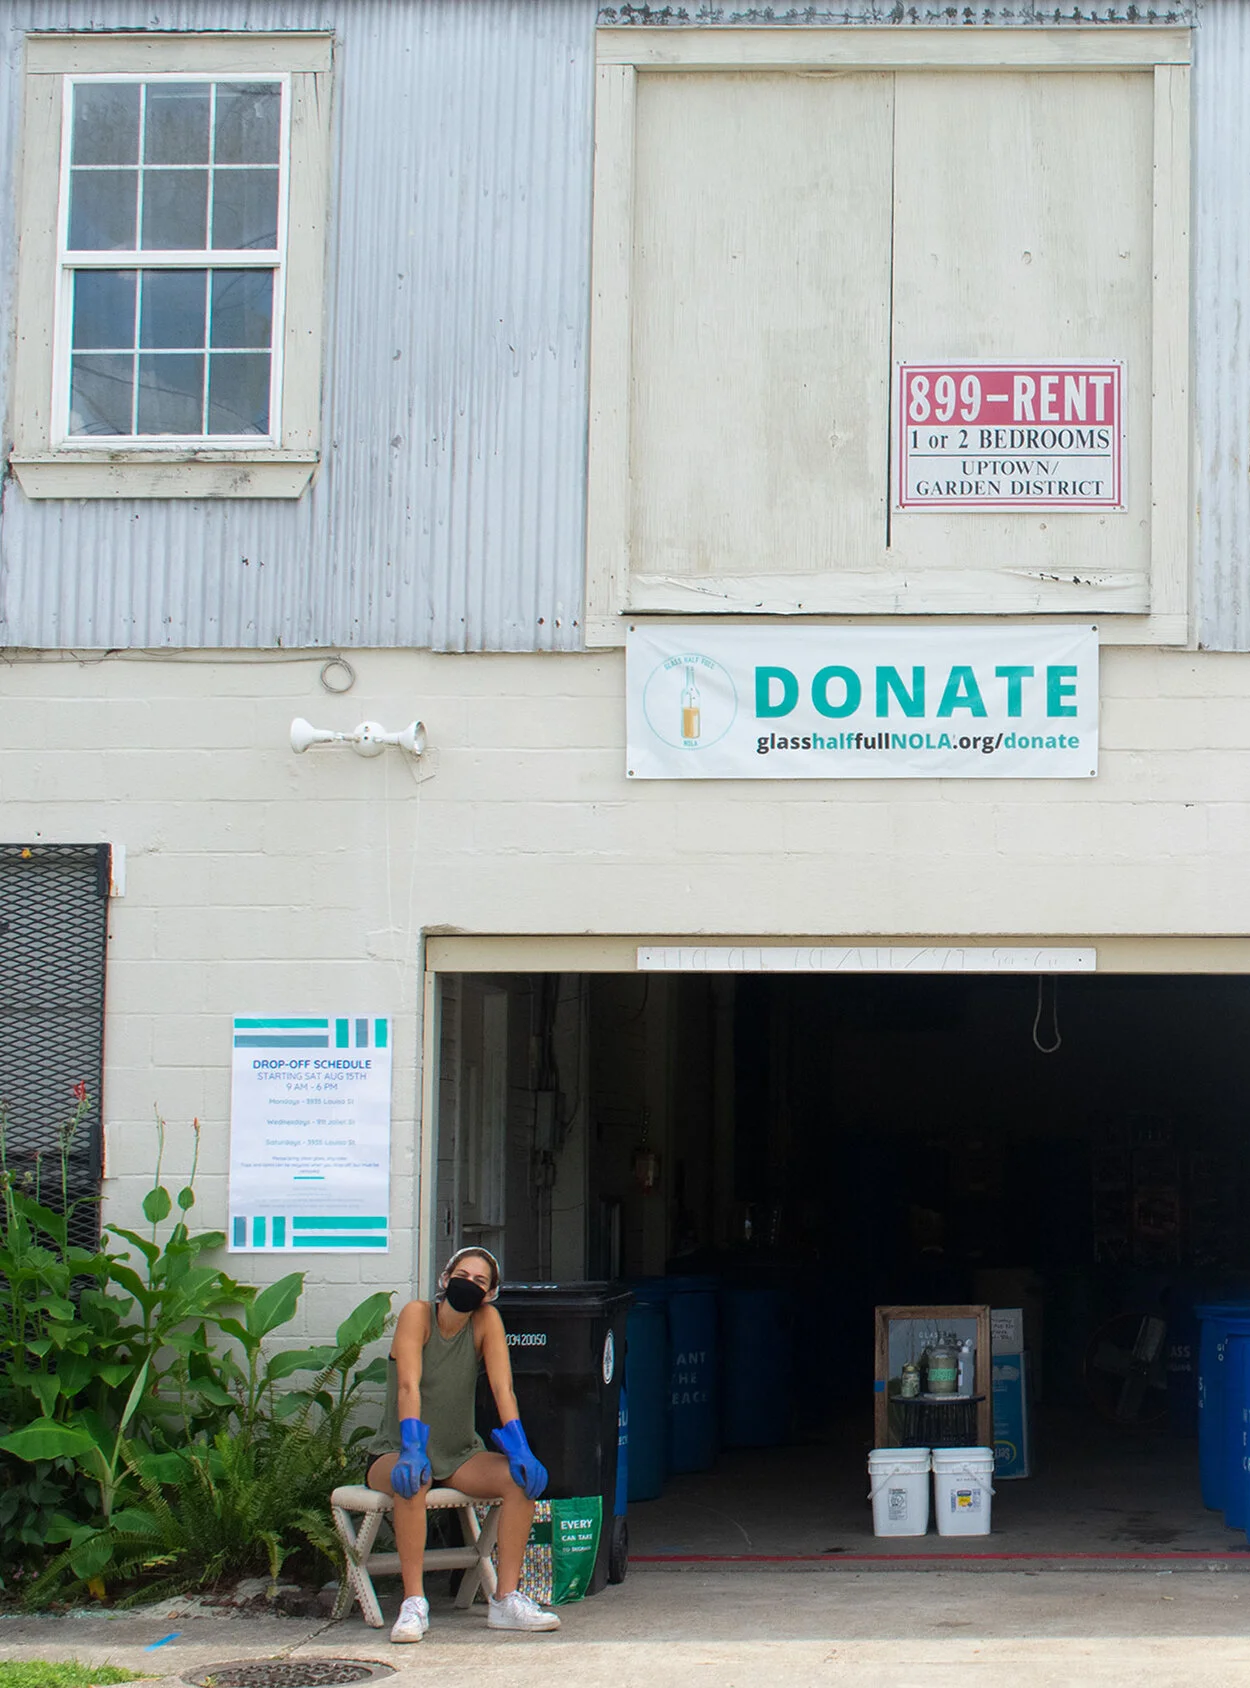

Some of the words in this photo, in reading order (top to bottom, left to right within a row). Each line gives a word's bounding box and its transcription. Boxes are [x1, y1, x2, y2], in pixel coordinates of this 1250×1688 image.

[908, 374, 1112, 422] 899-RENT
[911, 429, 919, 449] 1
[928, 433, 948, 449] or
[958, 429, 969, 449] 2
[979, 428, 1111, 449] BEDROOMS
[961, 460, 1060, 477] UPTOWN/
[916, 480, 1001, 496] GARDEN
[1010, 480, 1105, 496] DISTRICT
[754, 665, 1078, 719] DONATE
[757, 731, 1080, 756] glasshalffullNOLA.org/donate
[252, 1059, 311, 1070] DROP-OFF
[313, 1059, 372, 1070] SCHEDULE
[257, 1072, 303, 1081] STARTING
[304, 1072, 322, 1081] SAT
[324, 1072, 344, 1081] AUG
[345, 1072, 367, 1080] 15TH
[286, 1083, 292, 1091] 9
[294, 1083, 308, 1091] AM
[316, 1083, 322, 1091] 6
[324, 1082, 338, 1090] PM
[675, 1351, 707, 1367] ANT
[671, 1391, 709, 1405] EACE
[560, 1519, 593, 1531] EVERY
